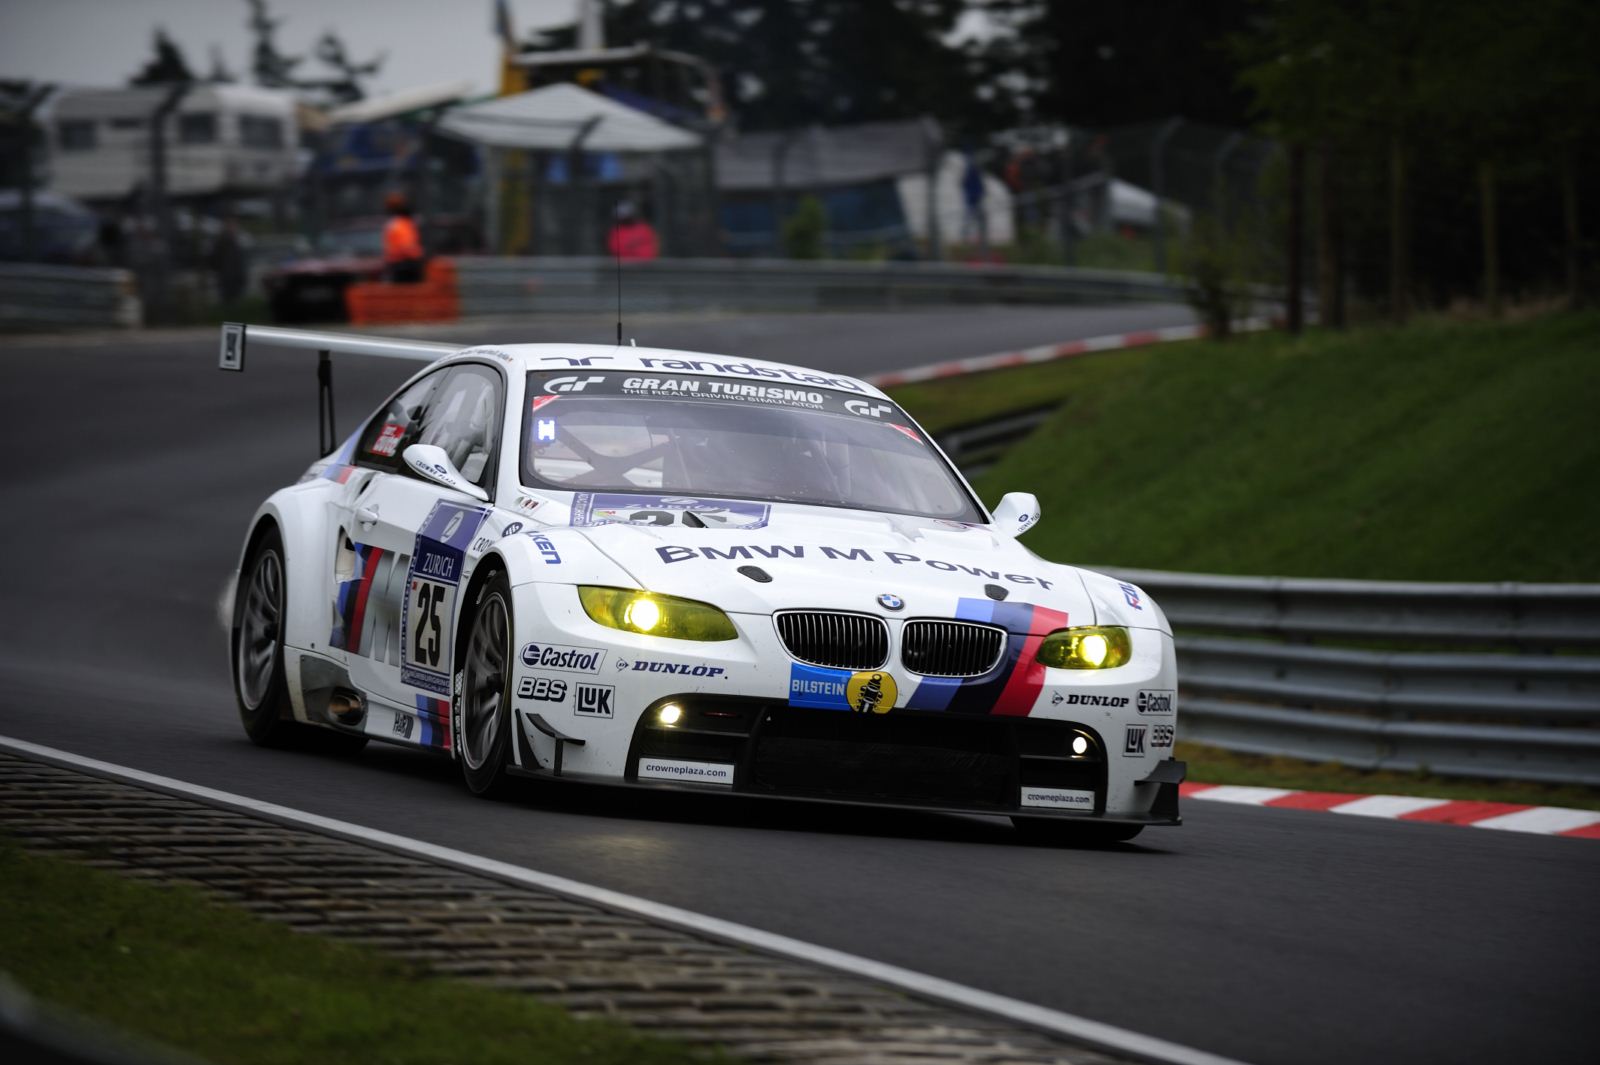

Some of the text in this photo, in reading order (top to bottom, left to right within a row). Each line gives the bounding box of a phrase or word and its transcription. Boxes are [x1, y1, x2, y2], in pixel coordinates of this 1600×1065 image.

[621, 388, 824, 410] THE REAL DRIVING SIMULATOR
[622, 377, 824, 404] GRAN TURISMO
[422, 552, 455, 578] ZURICH
[655, 544, 1056, 590] BMW M Power
[415, 582, 447, 667] 25
[541, 647, 600, 671] Castrol
[632, 660, 725, 678] DUNLOP
[517, 676, 568, 703] BBS
[791, 678, 845, 697] BILSTEIN
[1066, 693, 1130, 709] DUNLOP
[1147, 692, 1172, 712] Castrol
[1150, 724, 1175, 748] BBS
[646, 762, 728, 779] crowneplaza.com
[1027, 791, 1092, 805] crowneplaza.com
